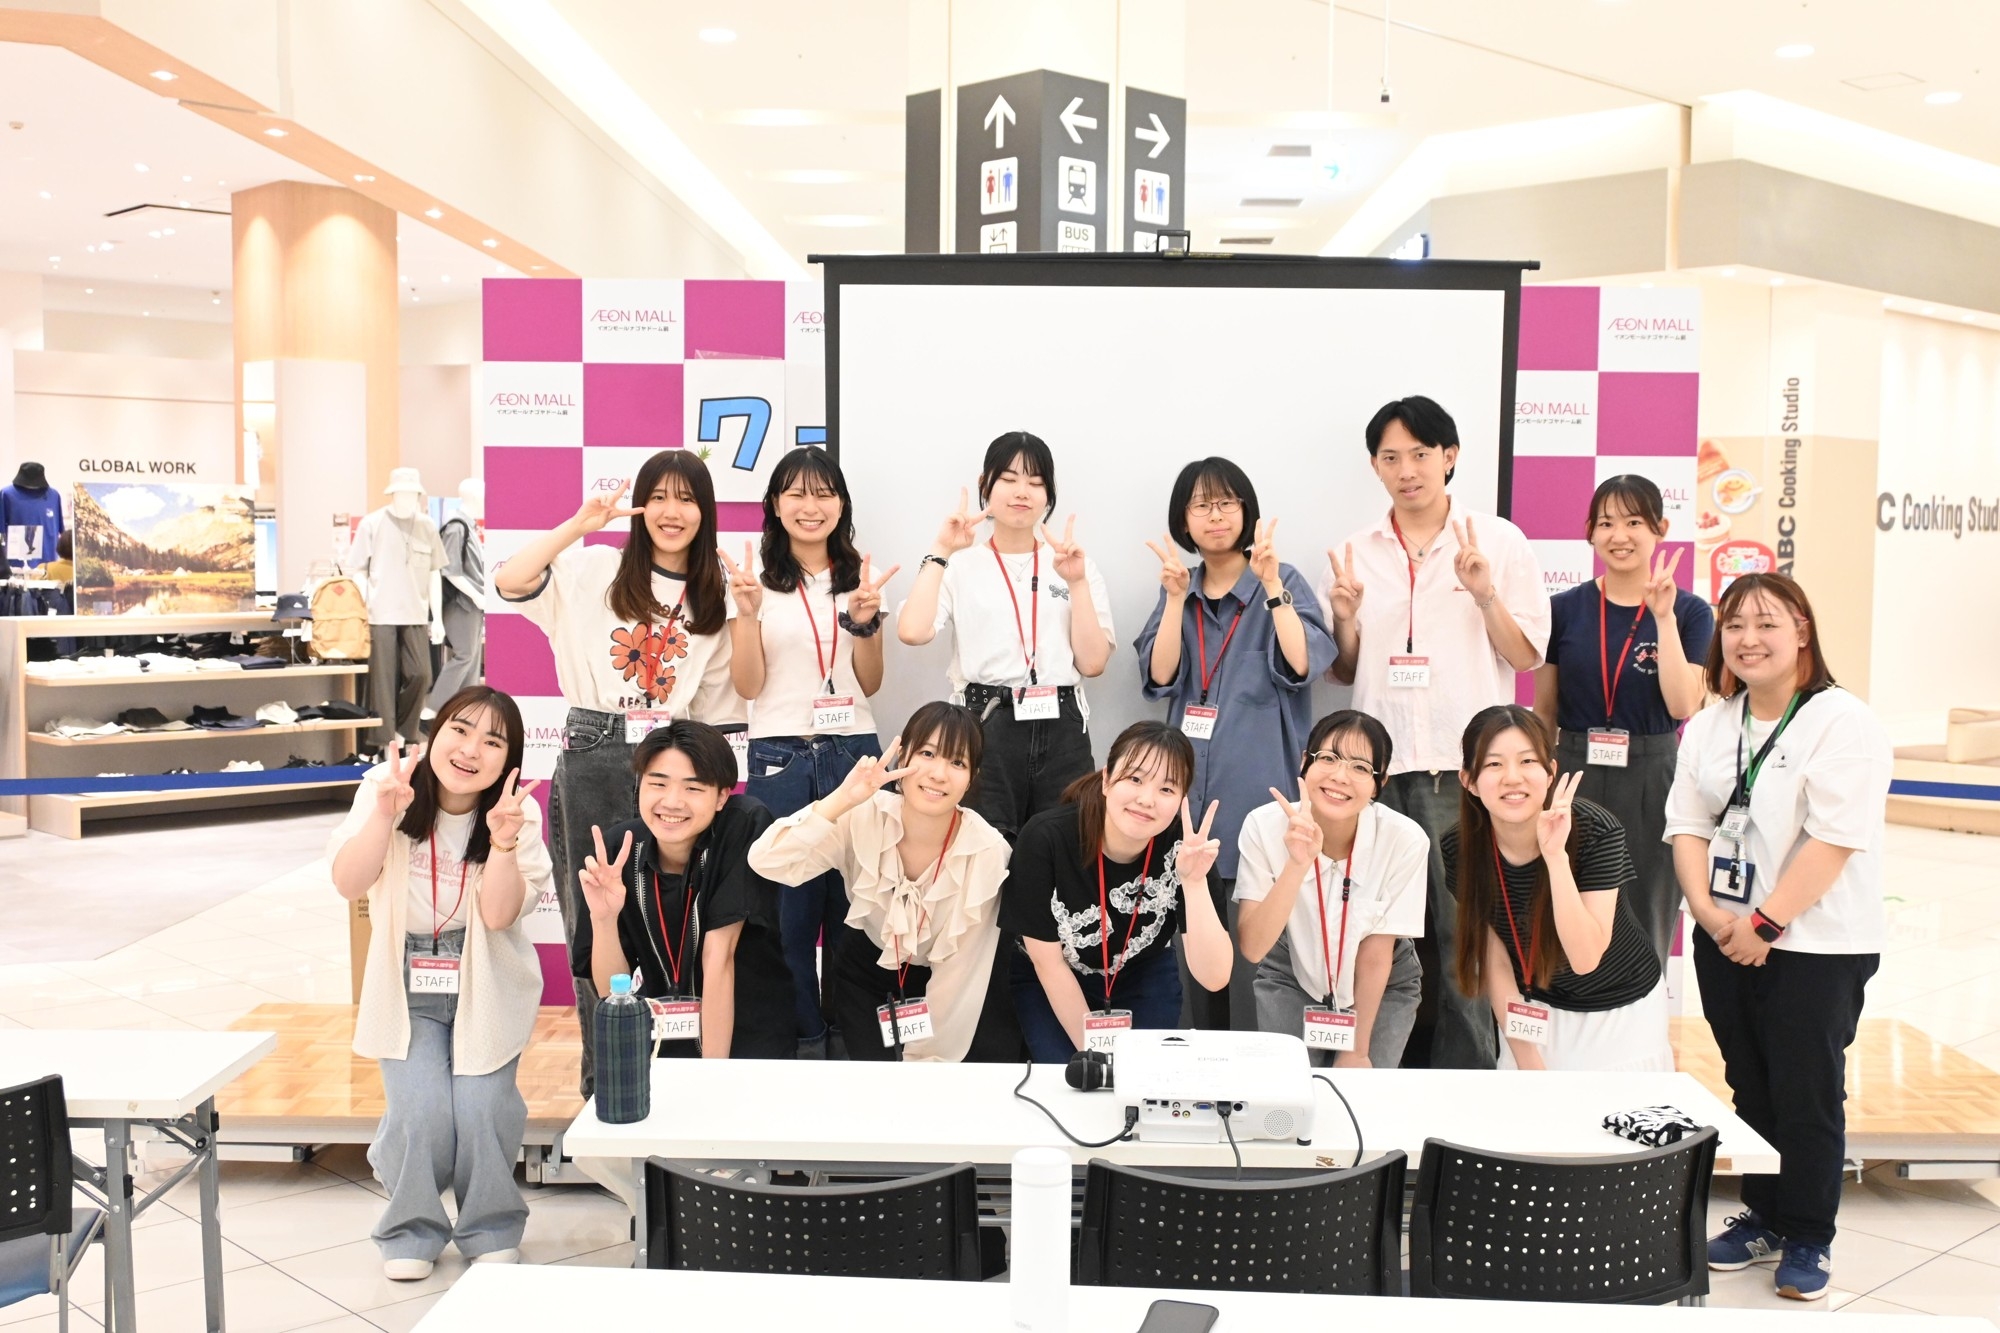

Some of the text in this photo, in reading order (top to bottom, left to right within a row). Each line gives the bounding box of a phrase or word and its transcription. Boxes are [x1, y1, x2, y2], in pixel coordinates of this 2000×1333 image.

[1064, 226, 1089, 242] BUS
[635, 310, 677, 322] MALL
[1652, 318, 1694, 331] MALL
[534, 393, 576, 406] MALL
[1548, 402, 1590, 415] MALL
[79, 459, 197, 474] GLOBAL WORK
[1777, 376, 1801, 580] ABC Cooking Studio
[1659, 488, 1689, 501] ALL
[1902, 493, 1963, 539] Cooking
[1968, 496, 2000, 532] Stud
[1543, 571, 1583, 584] MALL
[1392, 671, 1425, 682] STAFF
[1020, 703, 1054, 715] STAFF
[818, 711, 851, 725] STAFF
[1185, 721, 1210, 733] STAFF
[1592, 749, 1623, 761] STAFF
[415, 975, 454, 988] STAFF
[888, 1021, 926, 1039] STAFF
[1510, 1020, 1543, 1037] STAFF
[1089, 1036, 1117, 1048] STAF
[1310, 1030, 1349, 1044] STAFF
